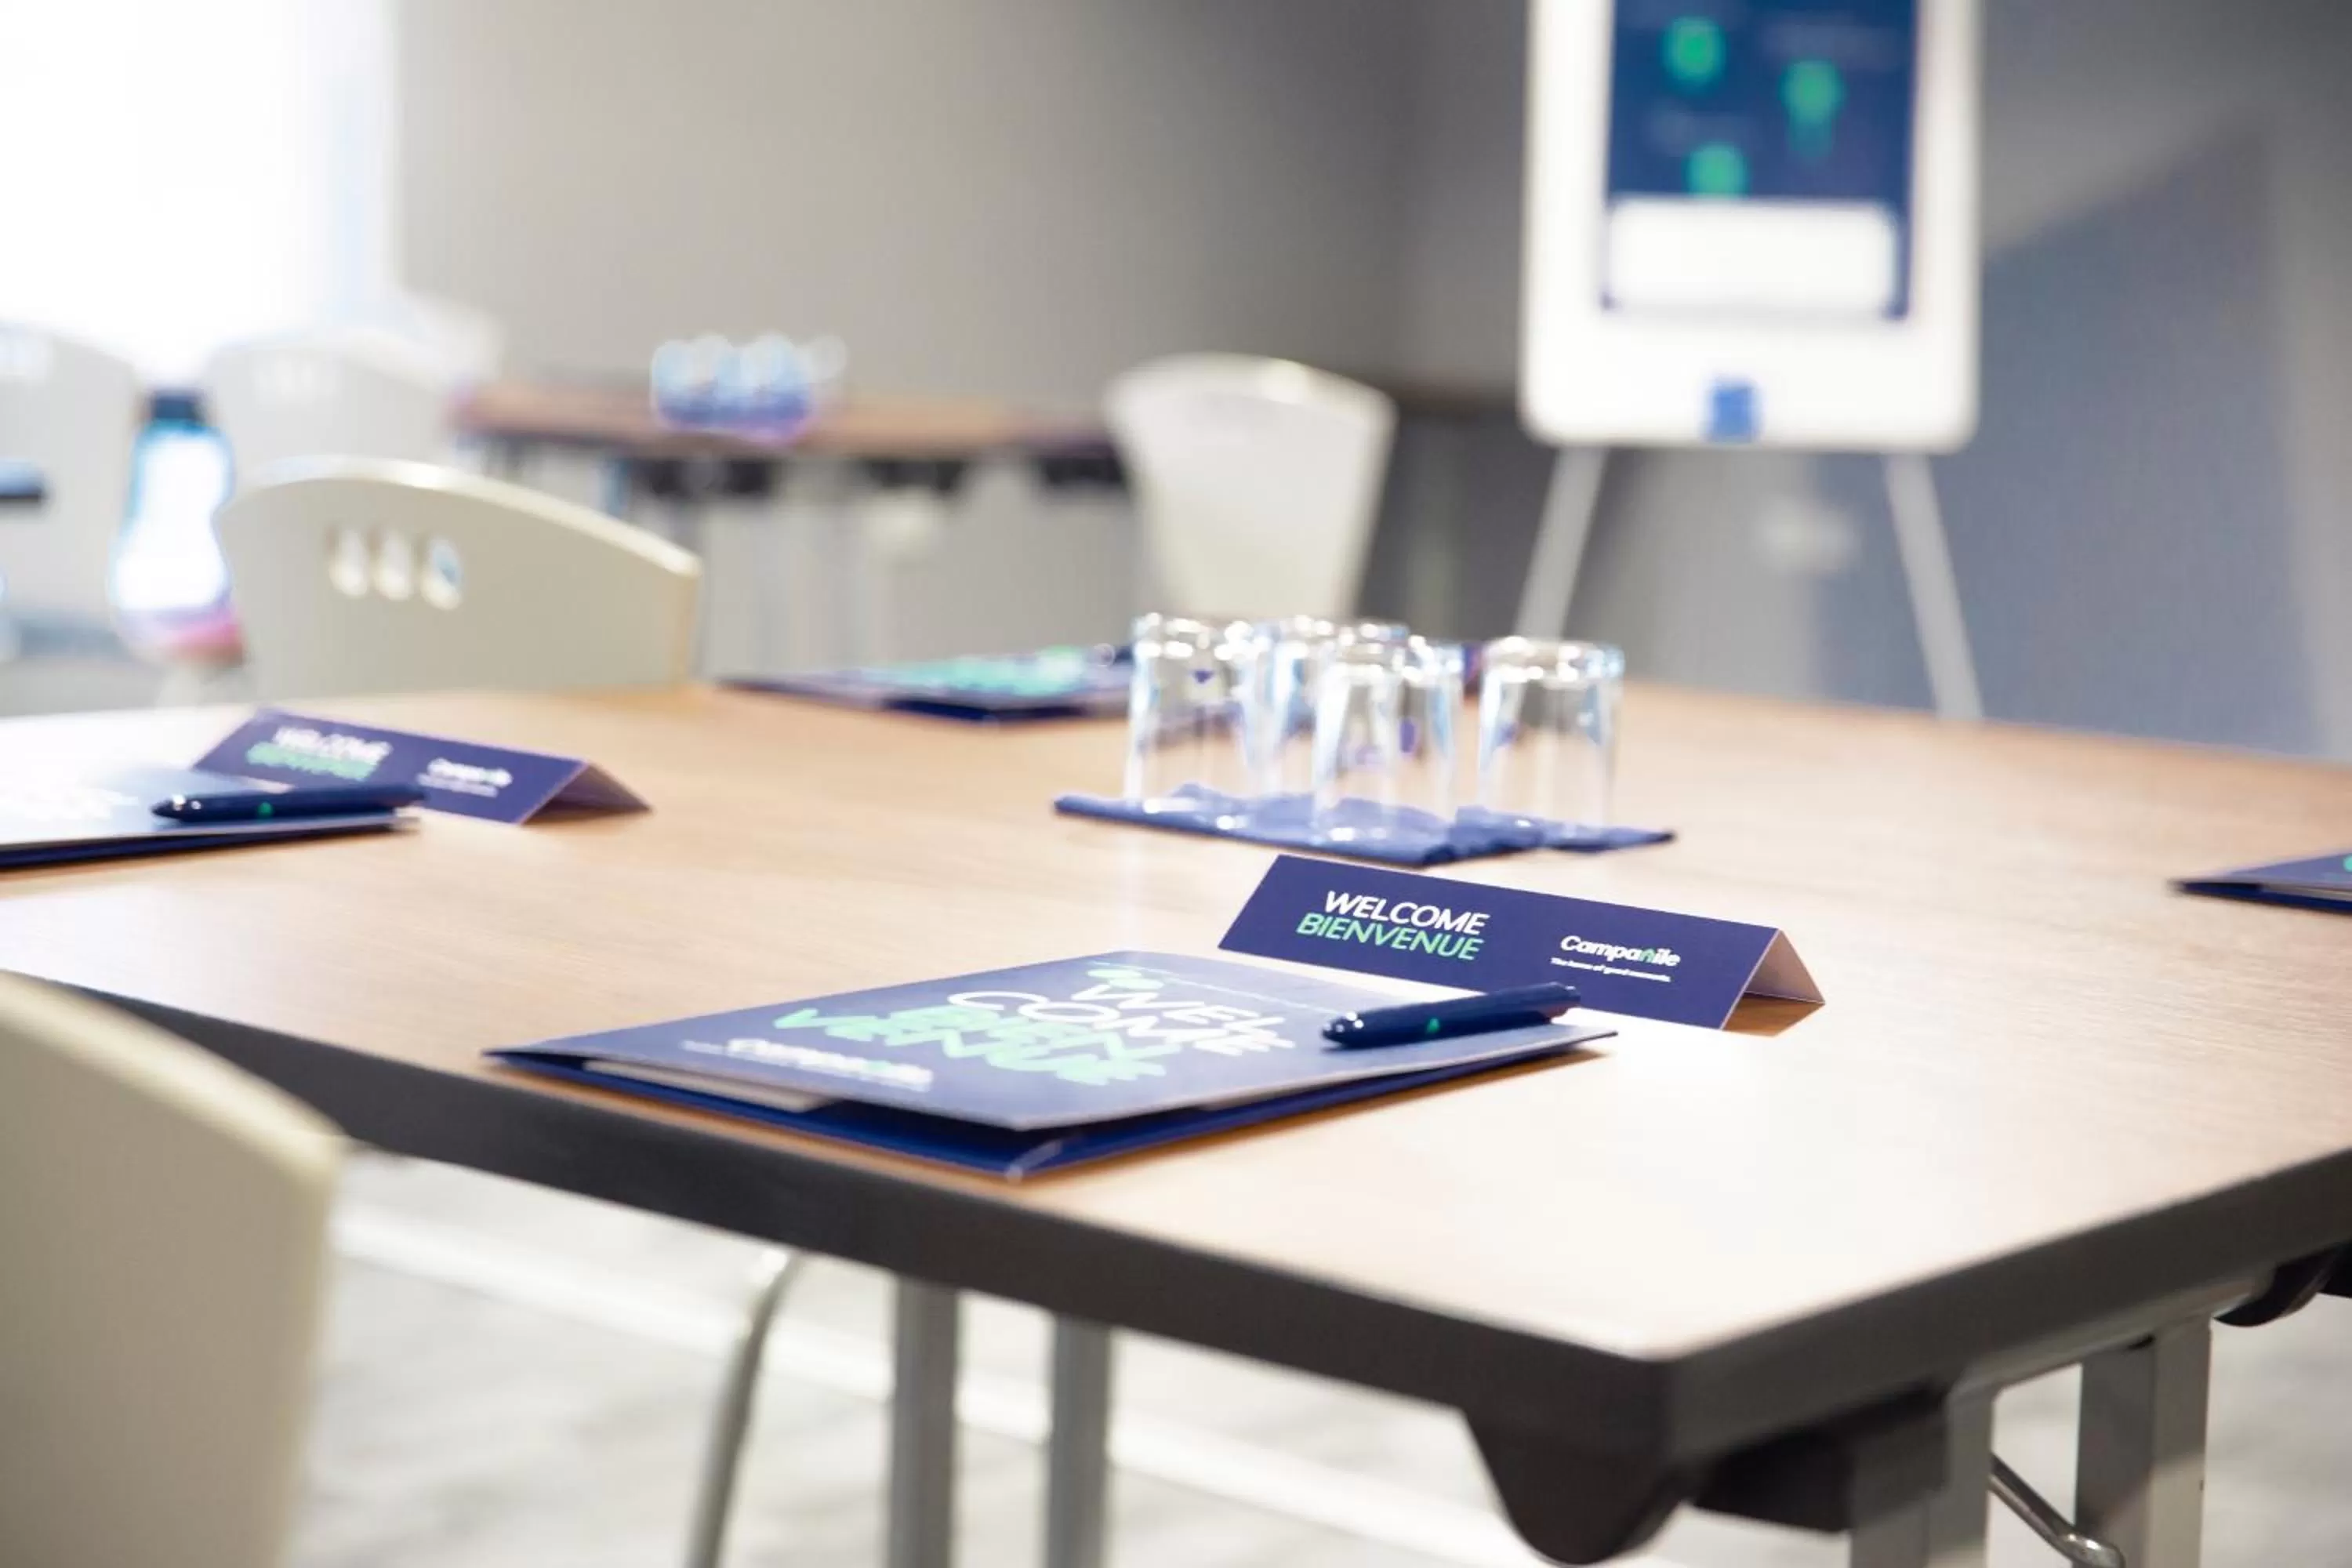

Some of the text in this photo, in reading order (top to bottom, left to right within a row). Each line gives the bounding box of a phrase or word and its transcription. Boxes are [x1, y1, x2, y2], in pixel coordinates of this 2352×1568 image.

[1324, 890, 1490, 935] WELCOME
[1296, 913, 1485, 960] BIENVENUE
[1560, 935, 1681, 967] Campanile
